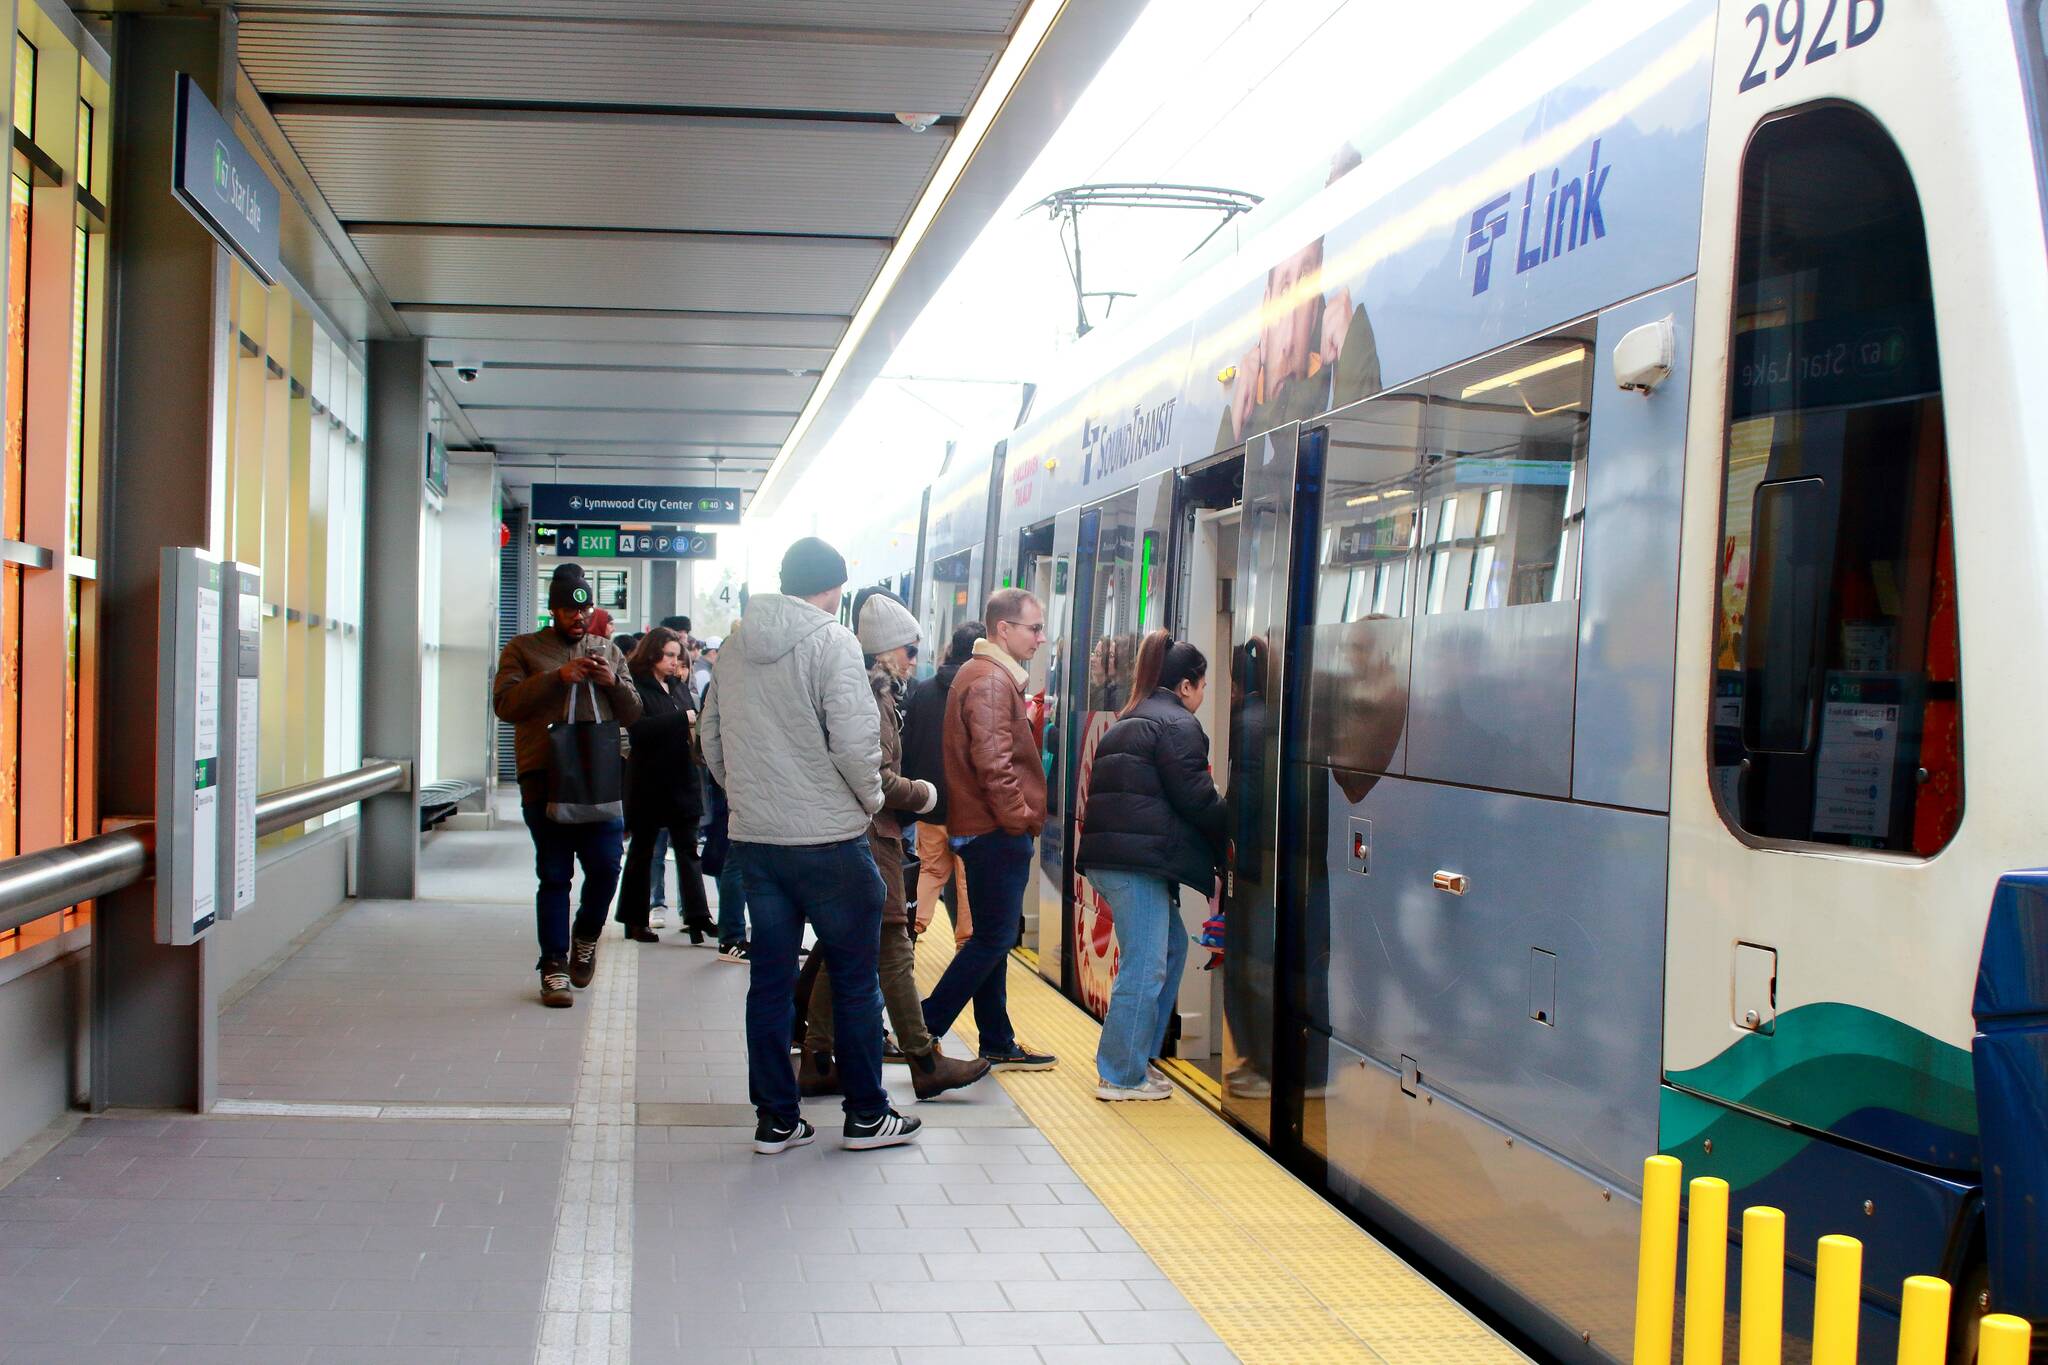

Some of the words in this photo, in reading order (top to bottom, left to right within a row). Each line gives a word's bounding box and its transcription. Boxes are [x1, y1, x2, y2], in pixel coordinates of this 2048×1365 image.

[221, 159, 229, 188] 67
[231, 167, 245, 215] Star
[246, 184, 261, 232] Lake
[1516, 138, 1611, 274] Link
[584, 498, 635, 510] Lynnwood
[637, 499, 656, 512] City
[659, 499, 693, 510] Center
[581, 536, 611, 550] EXIT
[622, 538, 632, 549] A
[719, 586, 730, 603] 4
